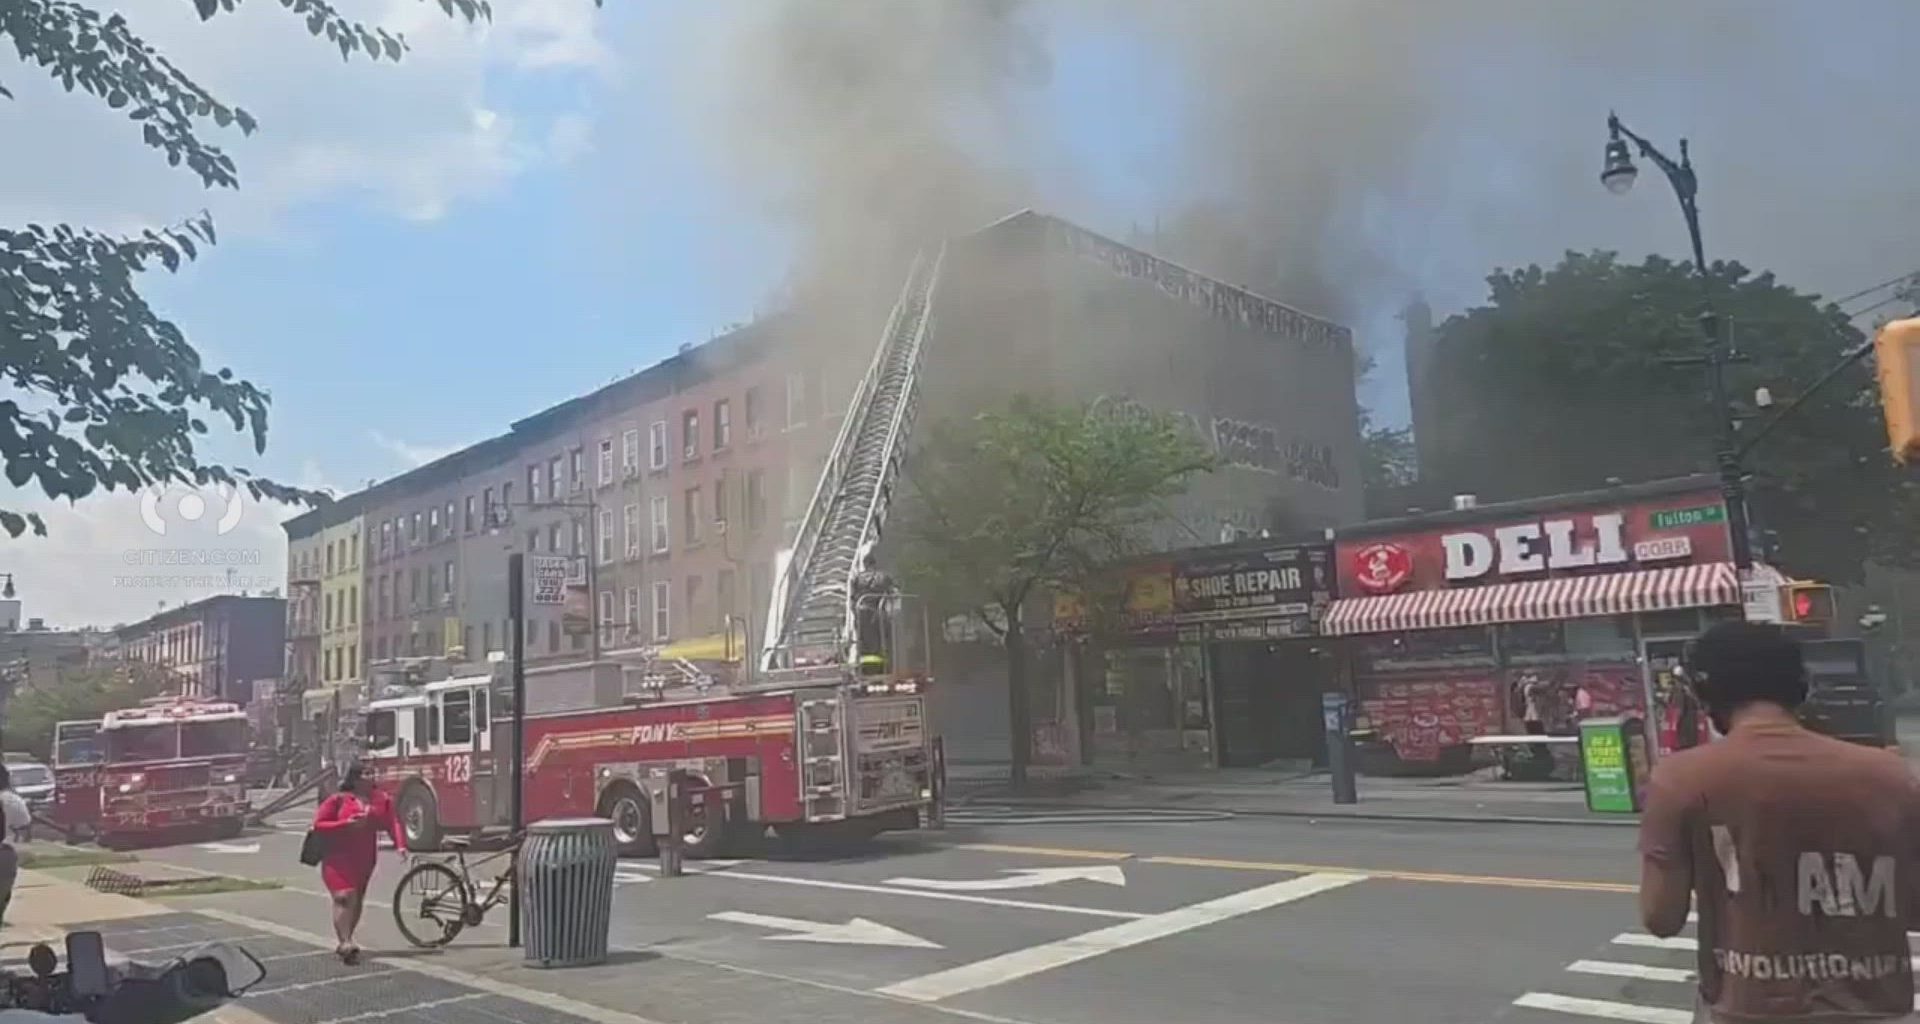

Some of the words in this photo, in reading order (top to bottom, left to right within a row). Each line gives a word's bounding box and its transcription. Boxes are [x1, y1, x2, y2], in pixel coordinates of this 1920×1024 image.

[1441, 514, 1626, 580] DELI
[1191, 574, 1232, 598] SHOE
[1234, 567, 1301, 594] REPAIR
[631, 723, 676, 745] FDNY
[444, 755, 470, 783] 123
[1797, 851, 1897, 918] AM
